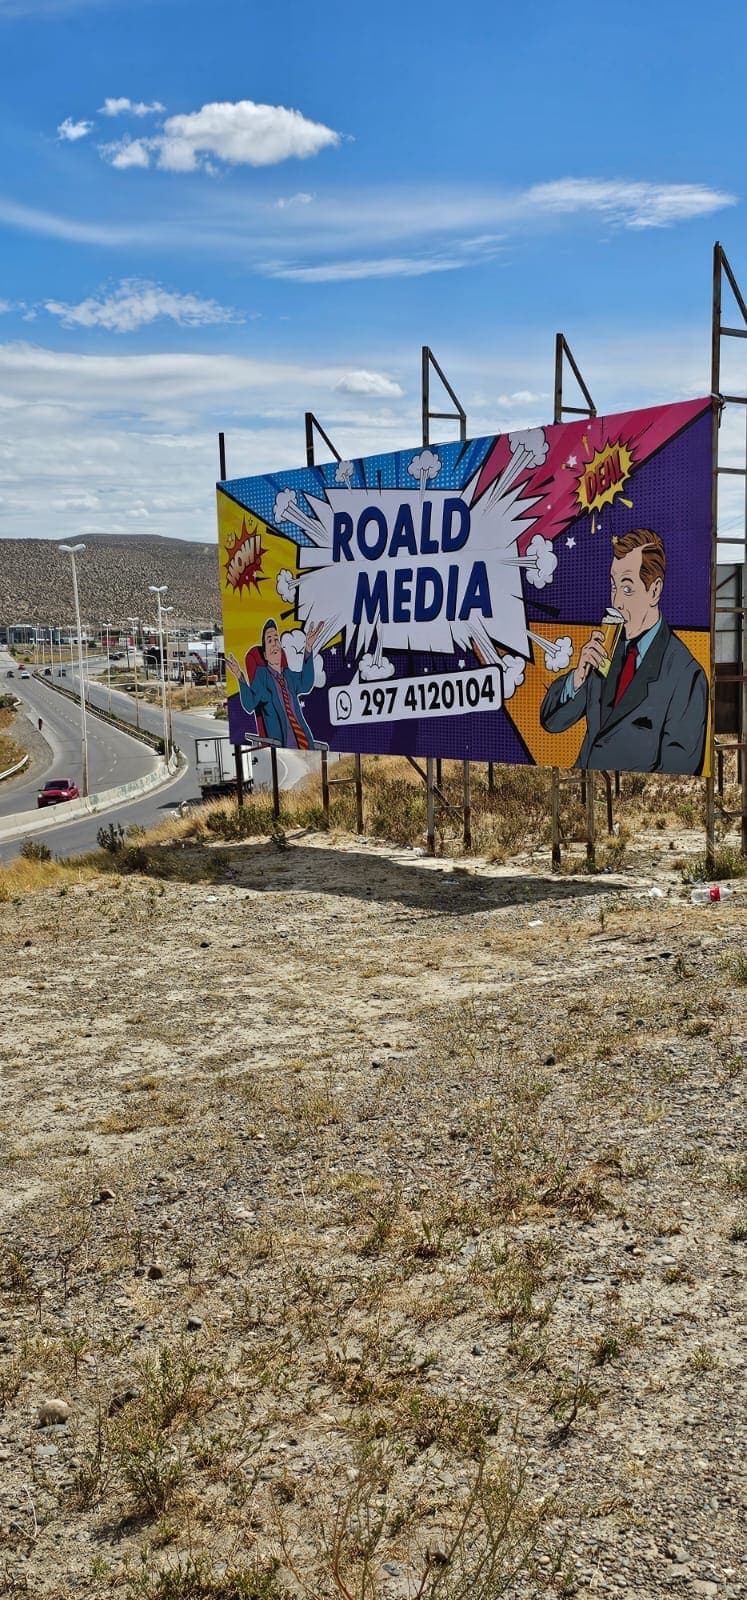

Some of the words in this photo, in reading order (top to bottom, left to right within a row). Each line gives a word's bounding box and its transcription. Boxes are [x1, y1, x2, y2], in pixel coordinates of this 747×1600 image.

[585, 448, 625, 504] DEAL
[332, 498, 471, 562] ROALD
[226, 534, 262, 587] WOW!
[352, 560, 493, 625] MEDIA
[359, 687, 398, 716] 297
[404, 674, 495, 711] 4120104
